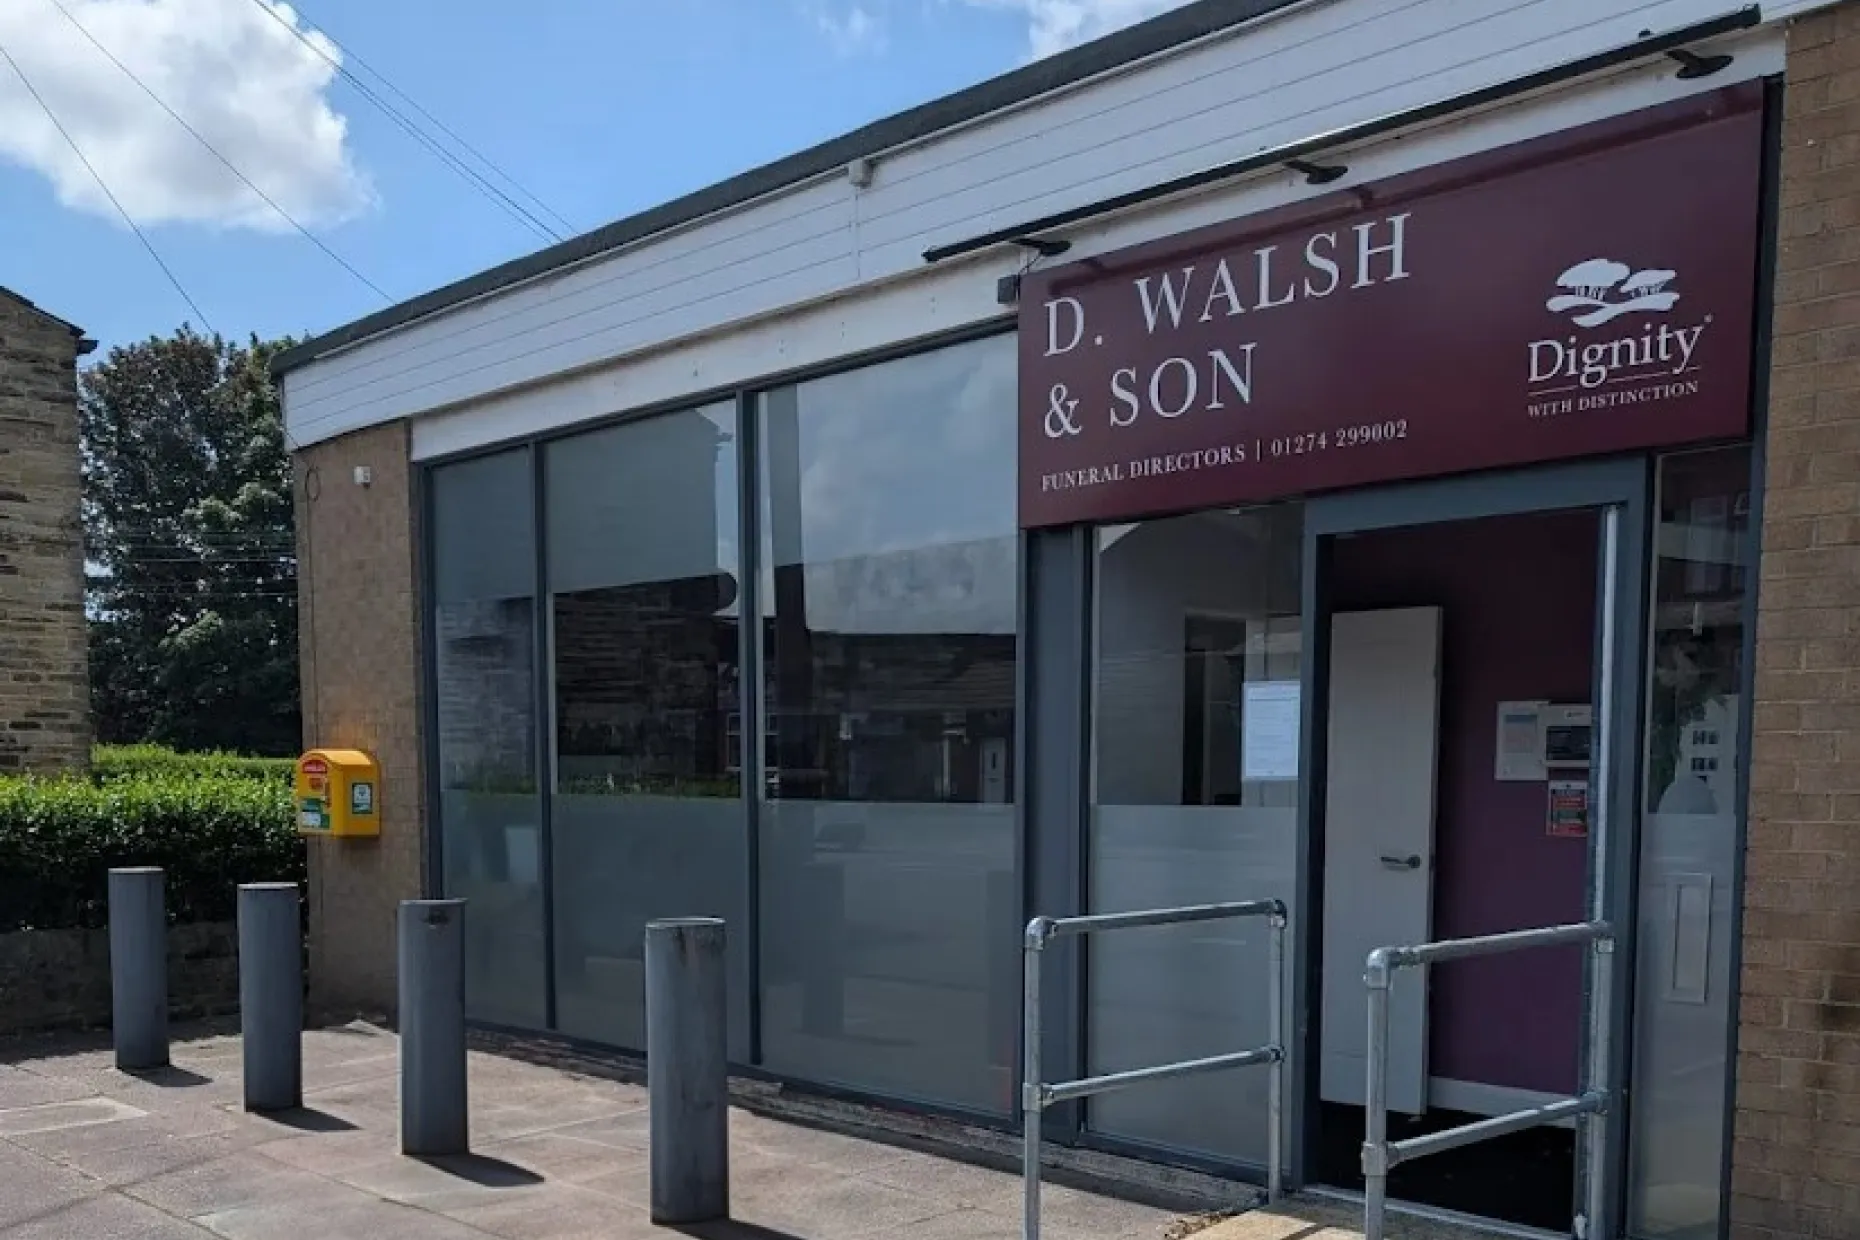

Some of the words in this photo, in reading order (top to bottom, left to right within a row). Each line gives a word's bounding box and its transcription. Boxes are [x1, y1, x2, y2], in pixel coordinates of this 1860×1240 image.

[1043, 296, 1103, 357] D.
[1133, 213, 1412, 335] WALSH
[1043, 382, 1083, 438] &
[1109, 342, 1258, 427] SON
[1527, 322, 1704, 388] Dignity
[1528, 399, 1573, 418] WITH
[1578, 381, 1699, 412] DISTINCTION
[1042, 466, 1124, 492] FUNERAL
[1130, 443, 1246, 479] DIRECTORS
[1270, 435, 1327, 457] 01274
[1336, 420, 1408, 448] 299002
